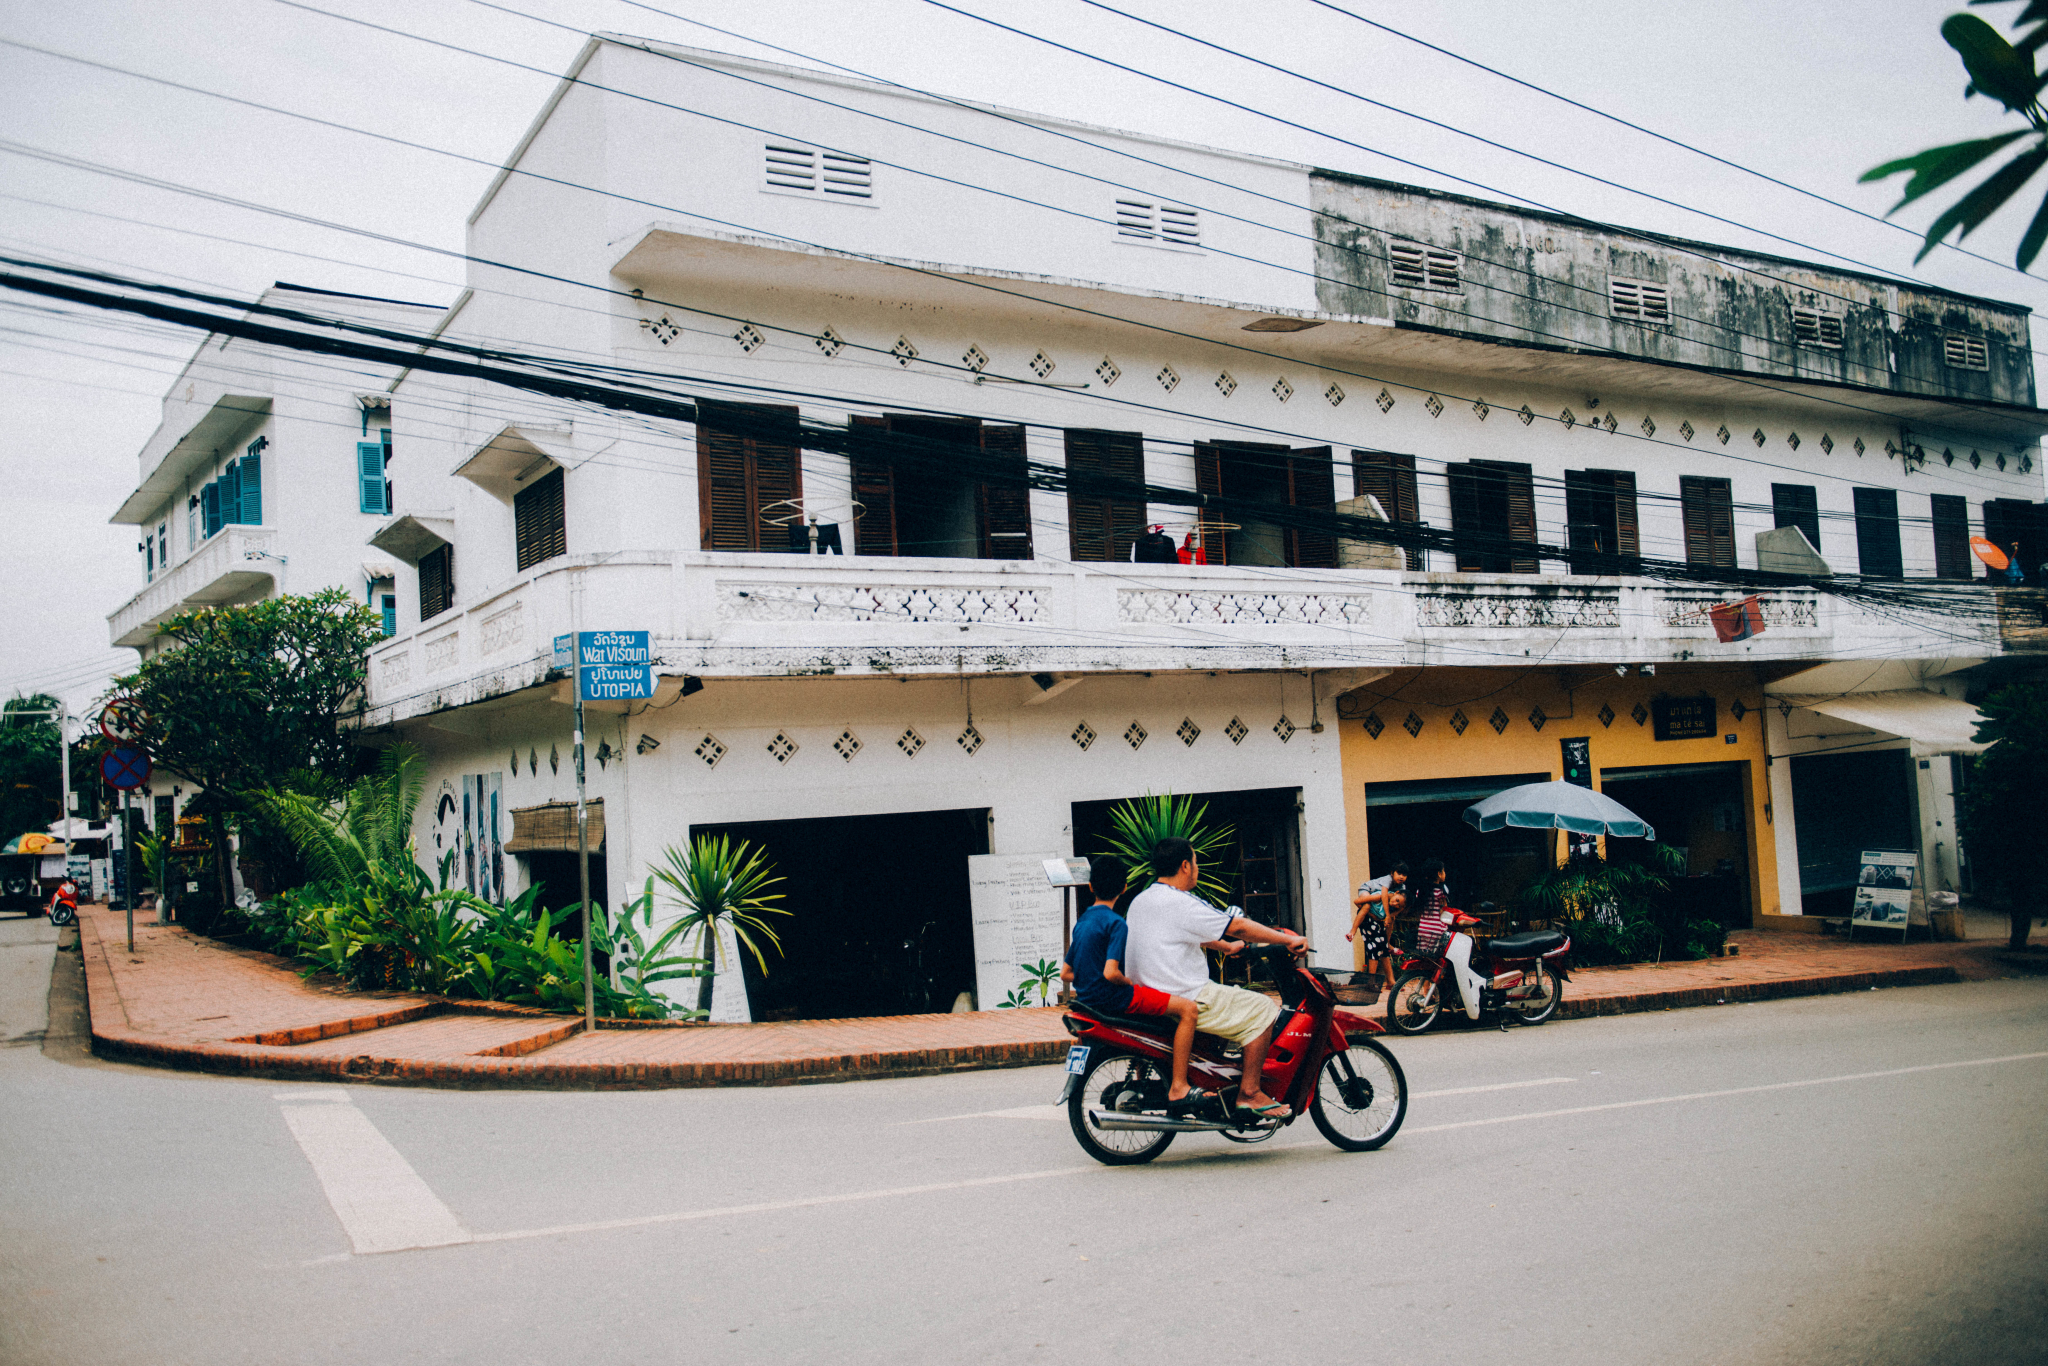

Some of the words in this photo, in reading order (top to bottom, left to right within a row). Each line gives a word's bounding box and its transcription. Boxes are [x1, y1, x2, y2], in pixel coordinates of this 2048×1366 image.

[582, 646, 605, 663] Wat
[606, 646, 647, 662] Visoun
[590, 682, 645, 698] UTOPIA
[1670, 721, 1681, 729] ma
[1694, 719, 1705, 728] sai
